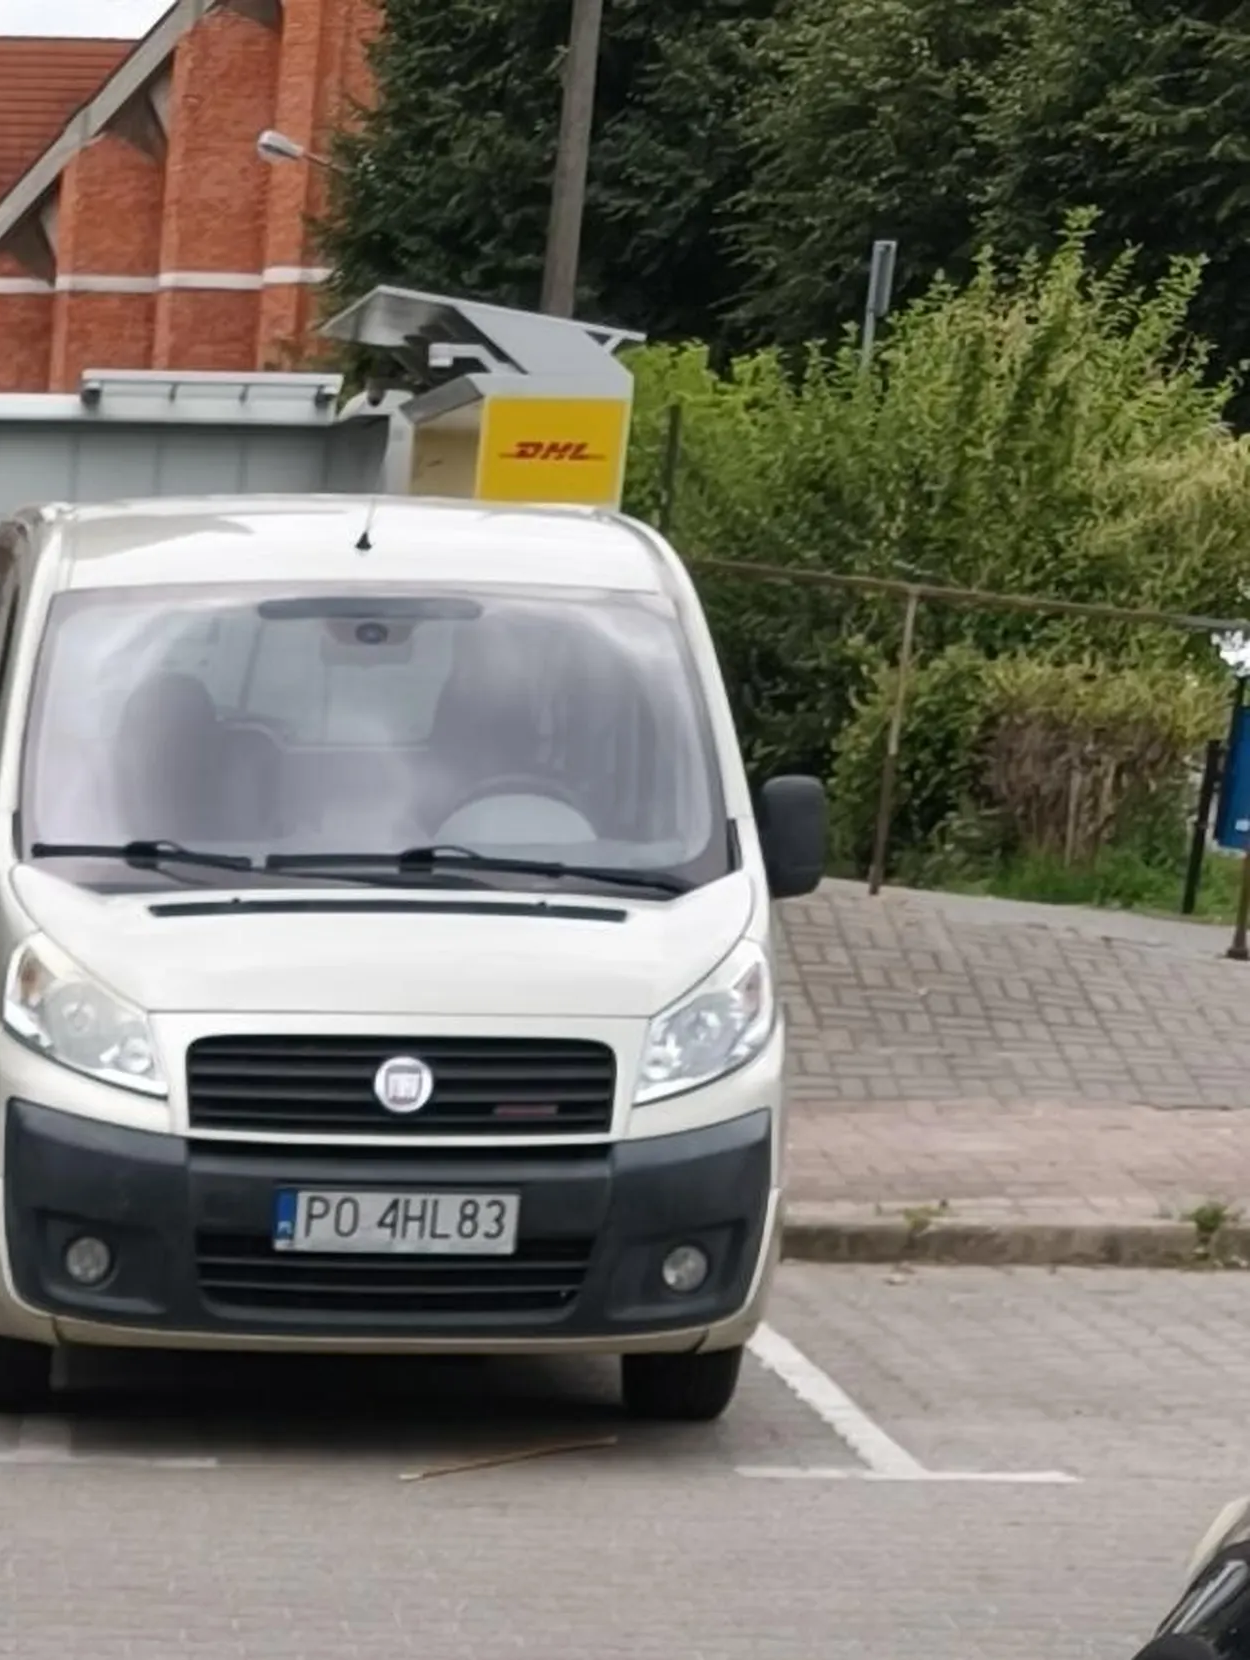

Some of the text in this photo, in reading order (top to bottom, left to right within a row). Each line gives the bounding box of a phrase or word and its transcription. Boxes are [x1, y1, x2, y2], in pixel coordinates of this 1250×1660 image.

[514, 440, 589, 461] DHL
[304, 1196, 360, 1238] PO
[377, 1198, 507, 1240] 4HL83
